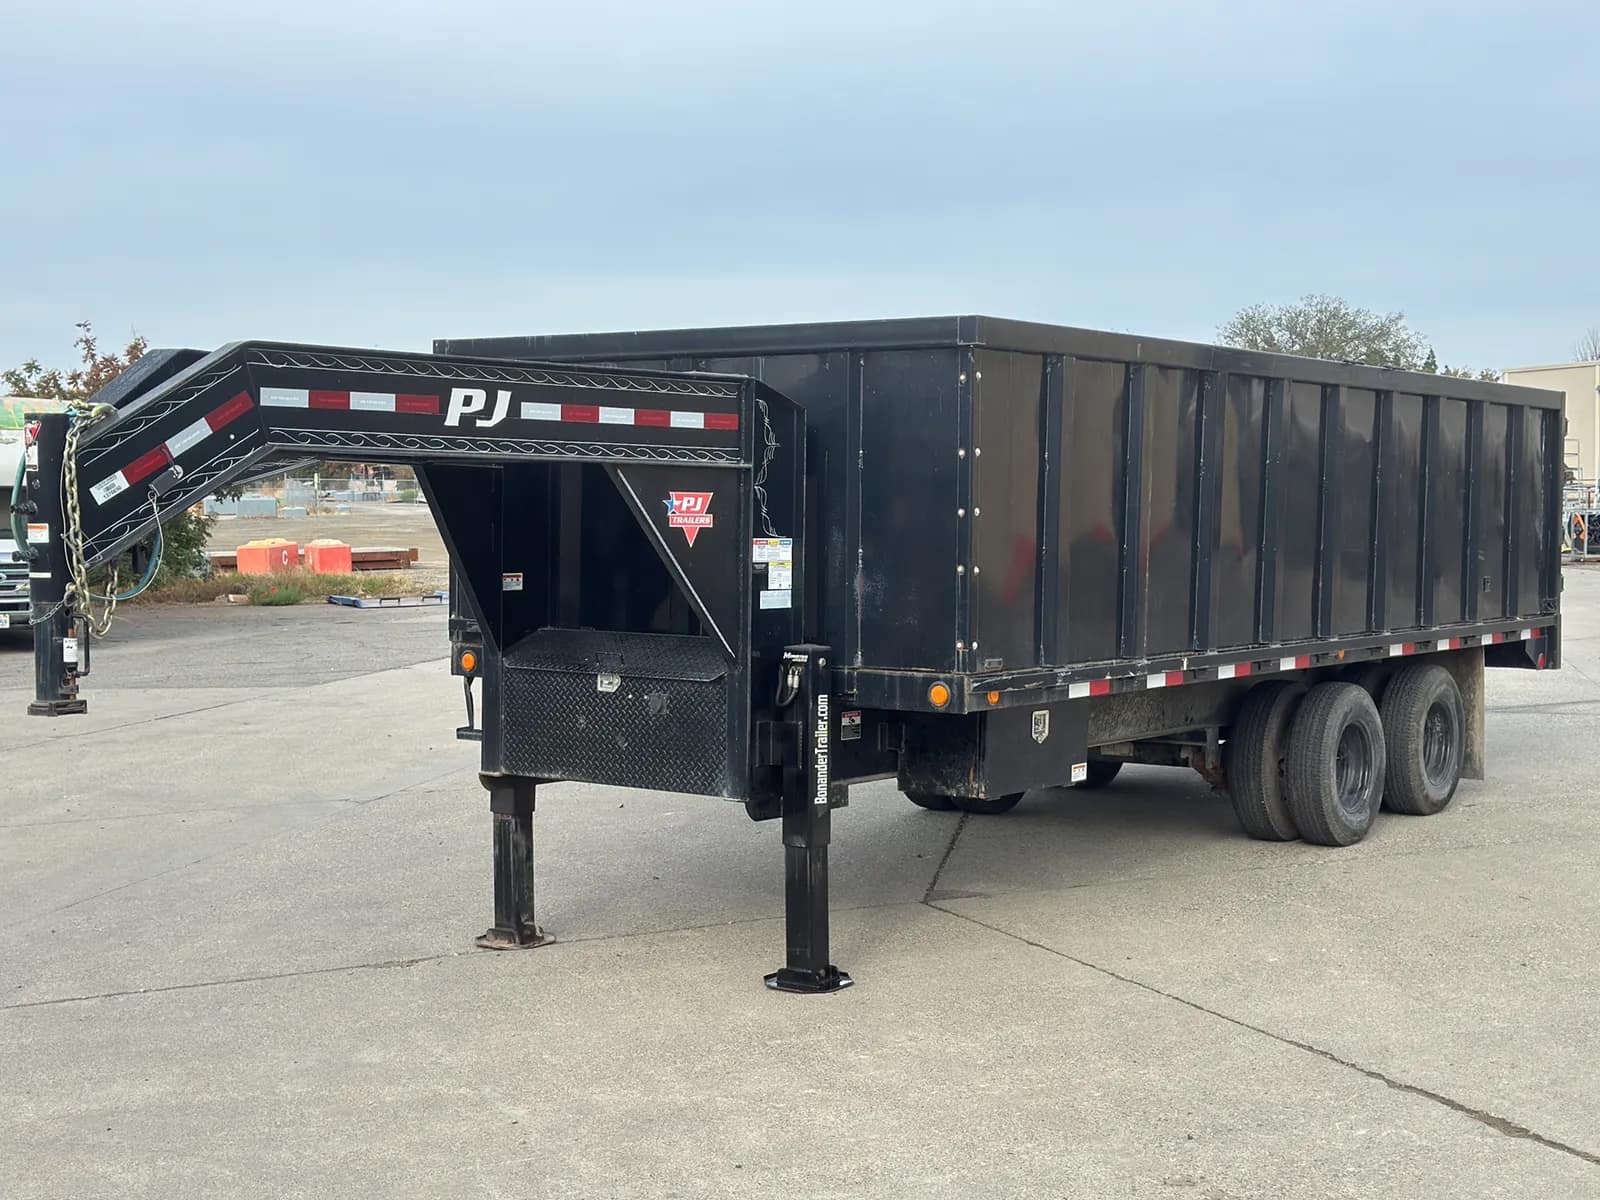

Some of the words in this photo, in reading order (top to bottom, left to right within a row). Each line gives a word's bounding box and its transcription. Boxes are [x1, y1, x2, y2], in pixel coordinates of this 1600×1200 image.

[444, 387, 512, 427] PJ
[681, 496, 703, 511] PJ
[671, 516, 711, 524] TRAILERS
[814, 694, 829, 805] BonanderTrailer.com
